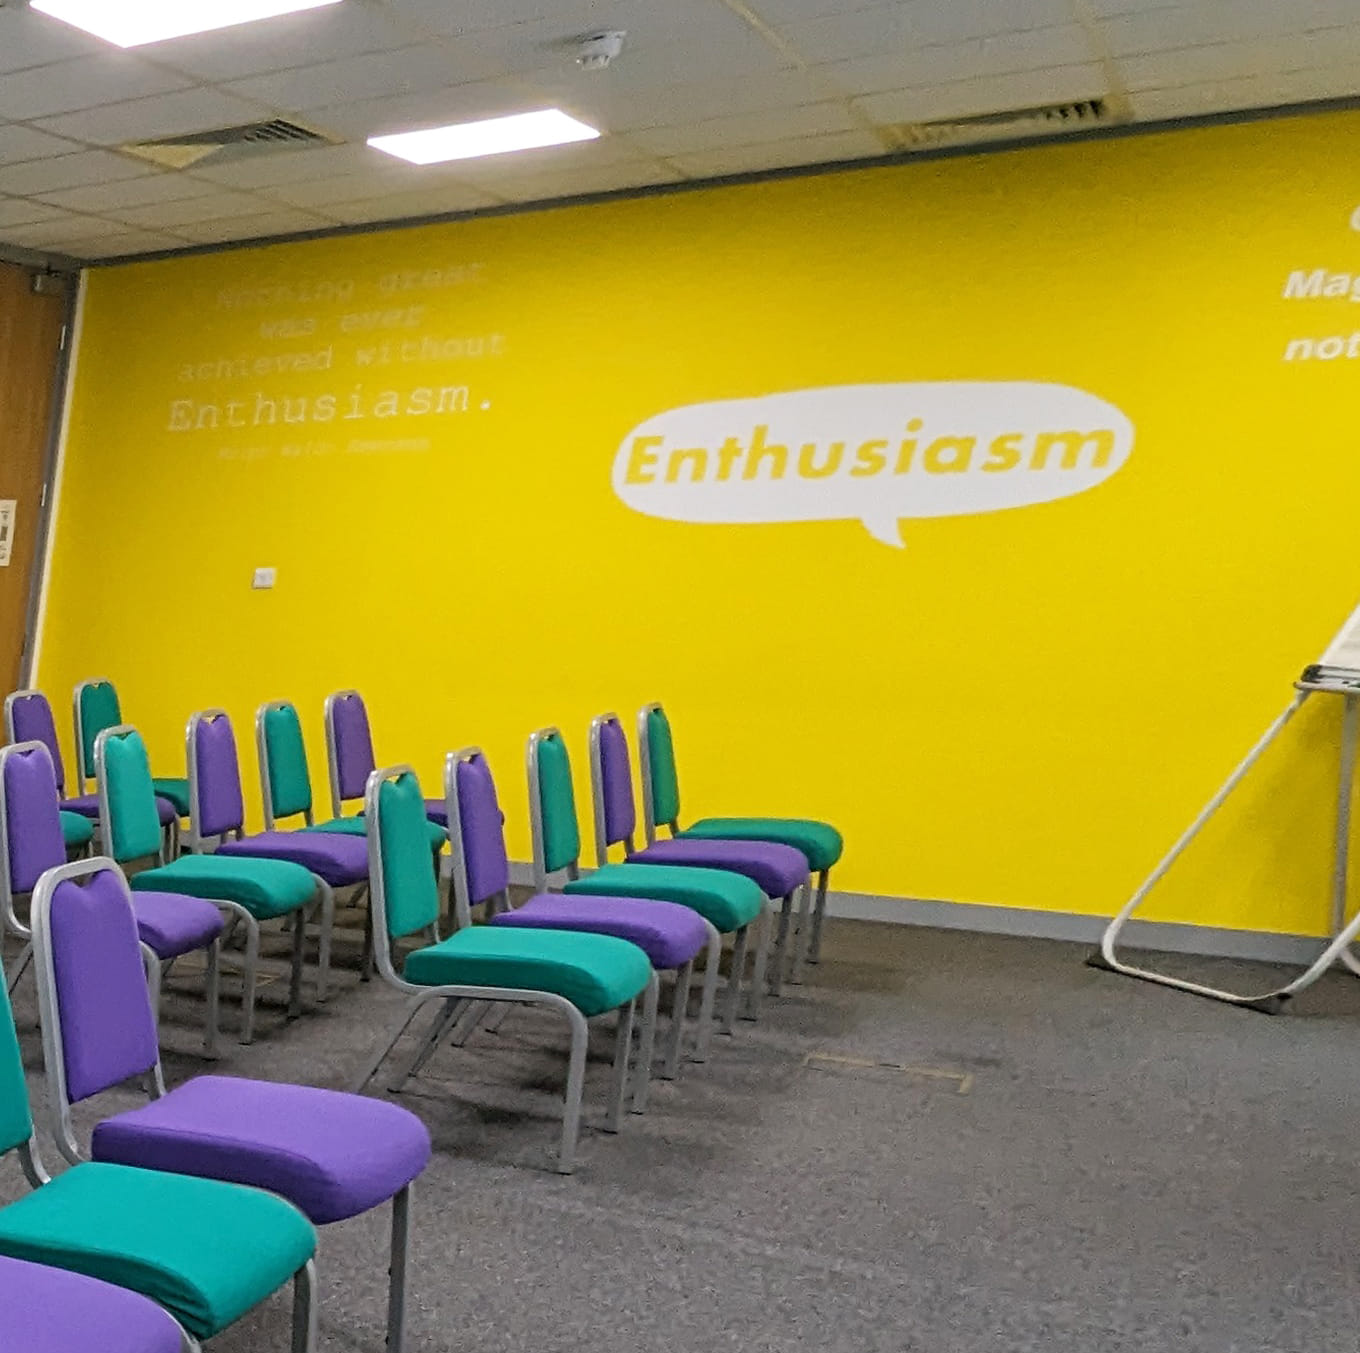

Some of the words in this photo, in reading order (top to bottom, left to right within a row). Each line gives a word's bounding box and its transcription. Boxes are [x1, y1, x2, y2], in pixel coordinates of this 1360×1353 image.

[338, 304, 427, 333] ever
[177, 345, 334, 383] achieved
[354, 332, 509, 368] without
[167, 384, 493, 432] Enthusiasm.
[623, 417, 1116, 485] Enthusiasm
